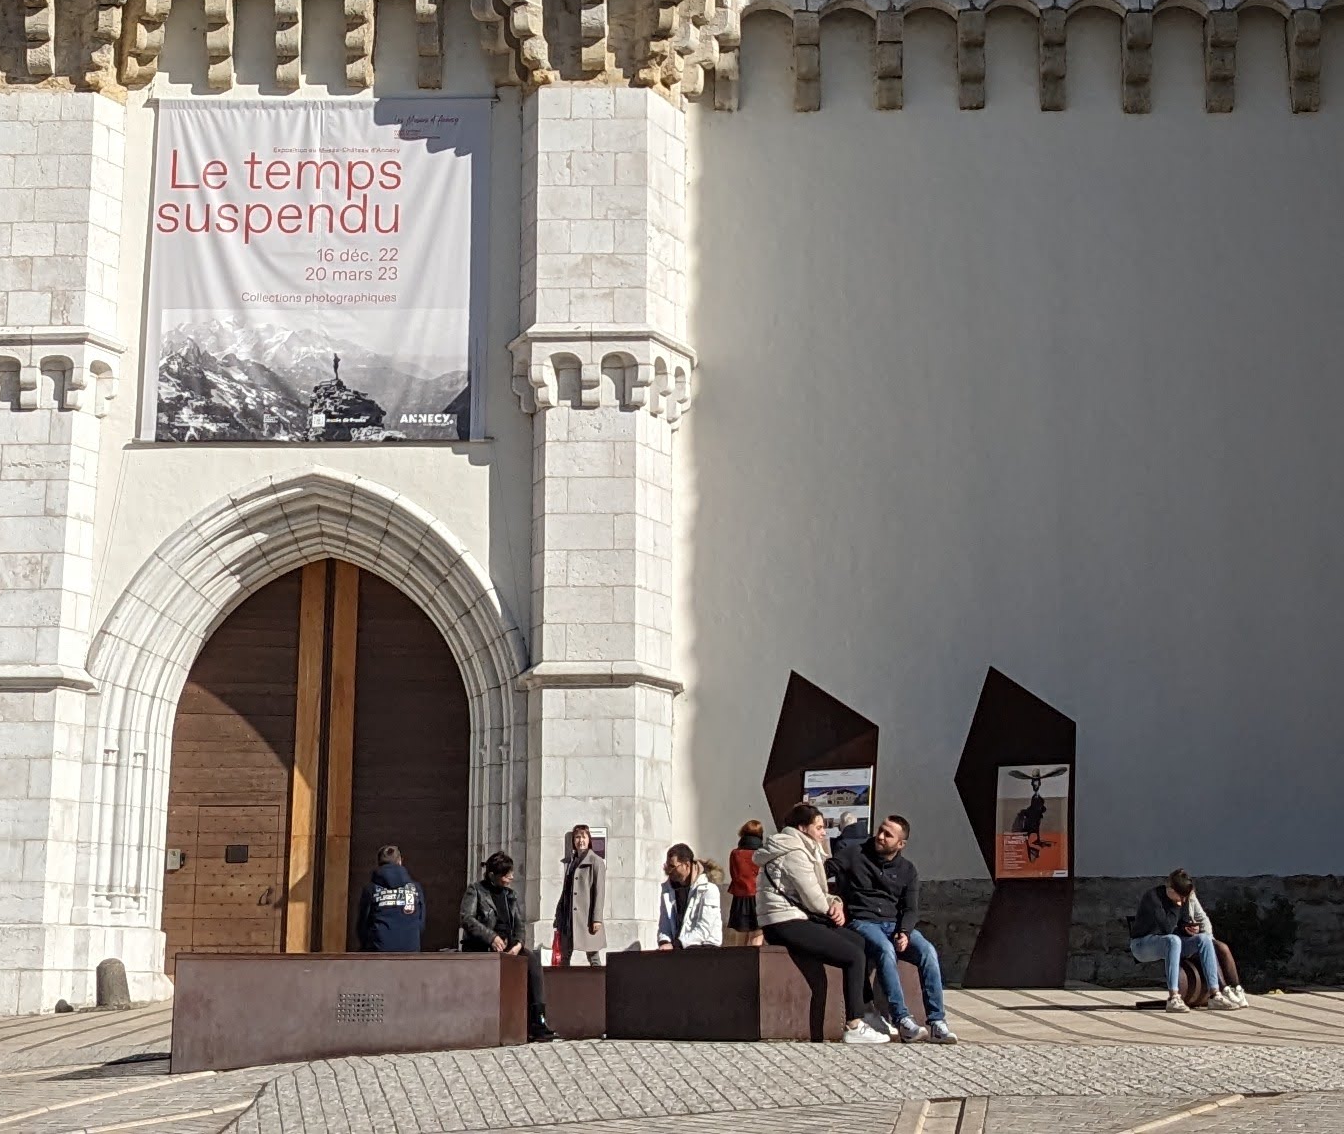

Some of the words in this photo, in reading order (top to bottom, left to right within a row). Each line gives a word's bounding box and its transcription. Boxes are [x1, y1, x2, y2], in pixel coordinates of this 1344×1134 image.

[170, 149, 228, 190] Le
[244, 152, 402, 201] temps
[156, 194, 400, 245] suspendu
[317, 248, 334, 262] 16
[339, 248, 373, 262] déc.
[379, 248, 399, 262] 22
[305, 267, 327, 281] 20
[332, 271, 373, 281] mars
[378, 267, 398, 281] 23
[241, 292, 302, 303] Collections
[304, 292, 397, 305] photographiques
